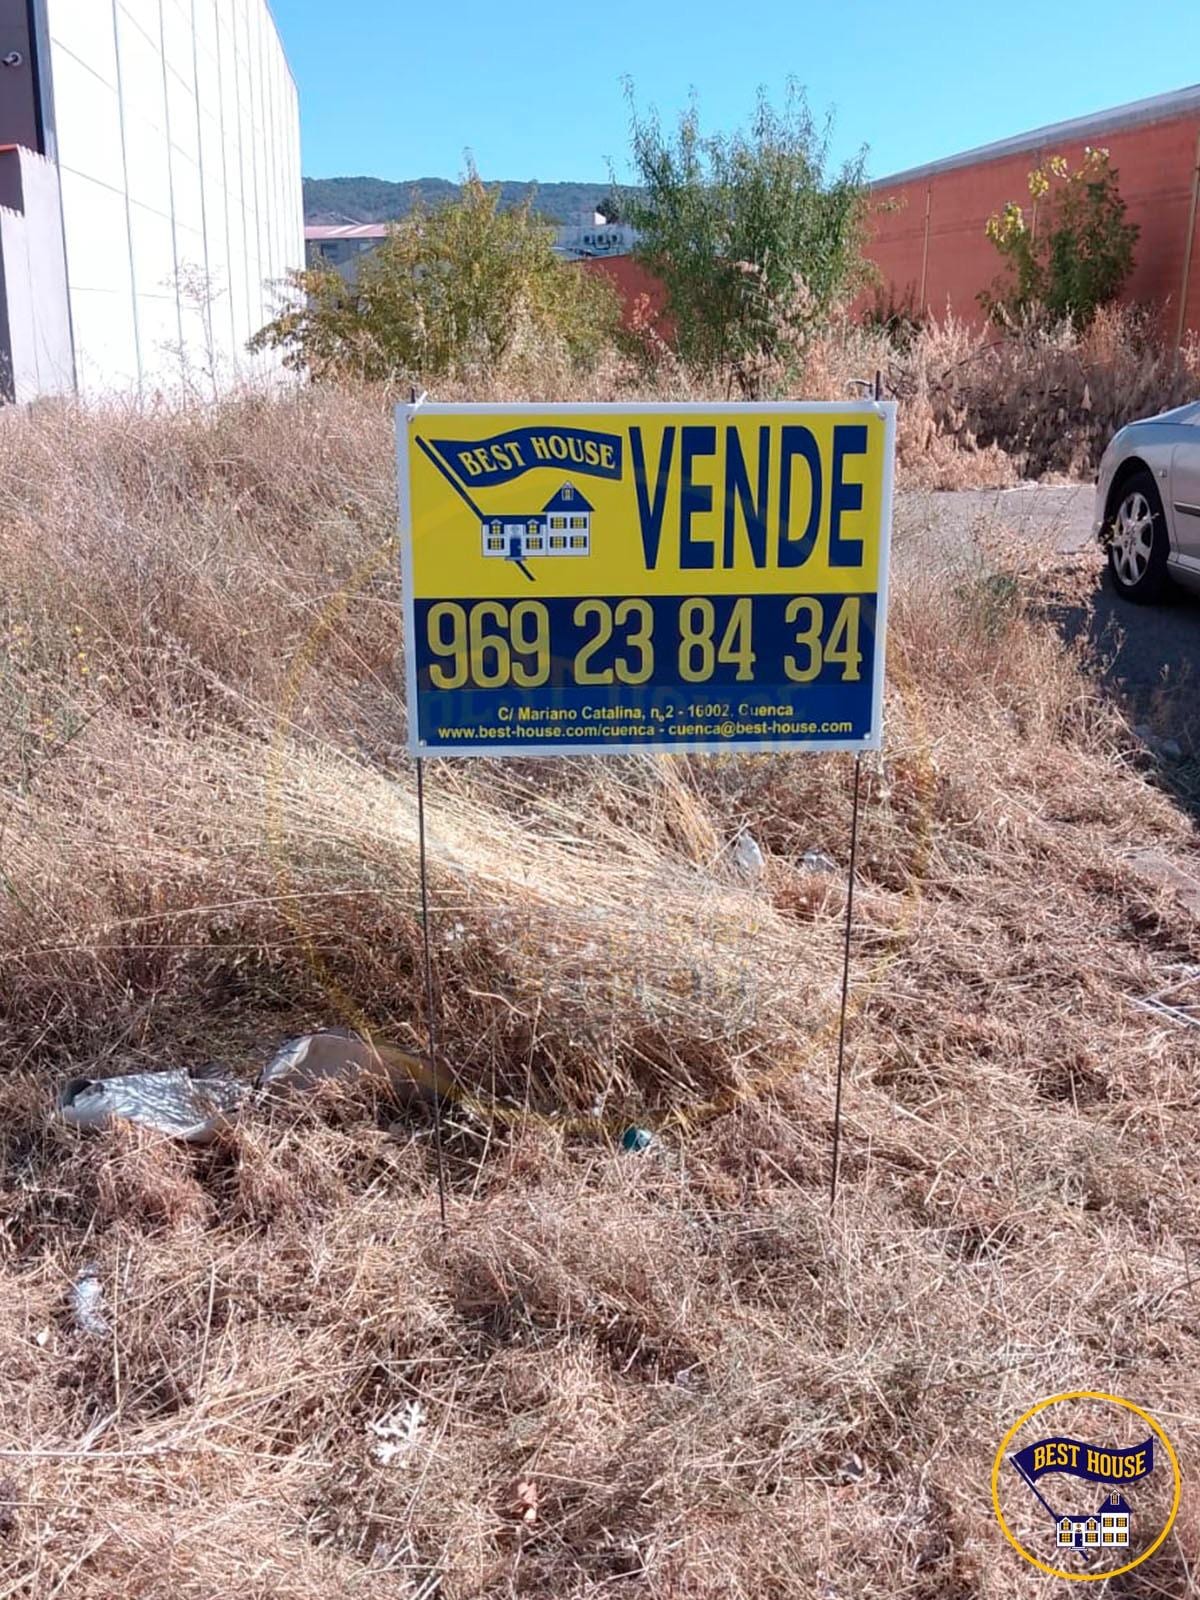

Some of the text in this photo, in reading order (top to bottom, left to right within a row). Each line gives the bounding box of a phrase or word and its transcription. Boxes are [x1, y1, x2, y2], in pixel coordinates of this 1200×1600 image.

[457, 435, 616, 476] BEST HOUSE
[628, 425, 868, 570] VENDE
[427, 596, 863, 690] 969 23 84 34
[438, 724, 655, 739] www.best-house.com/cuenca
[668, 720, 853, 738] cuenca@best-house.com
[497, 706, 514, 721] C/
[518, 706, 577, 721] Mariano
[581, 705, 646, 721] Catalina,
[738, 703, 794, 717] Cuenca
